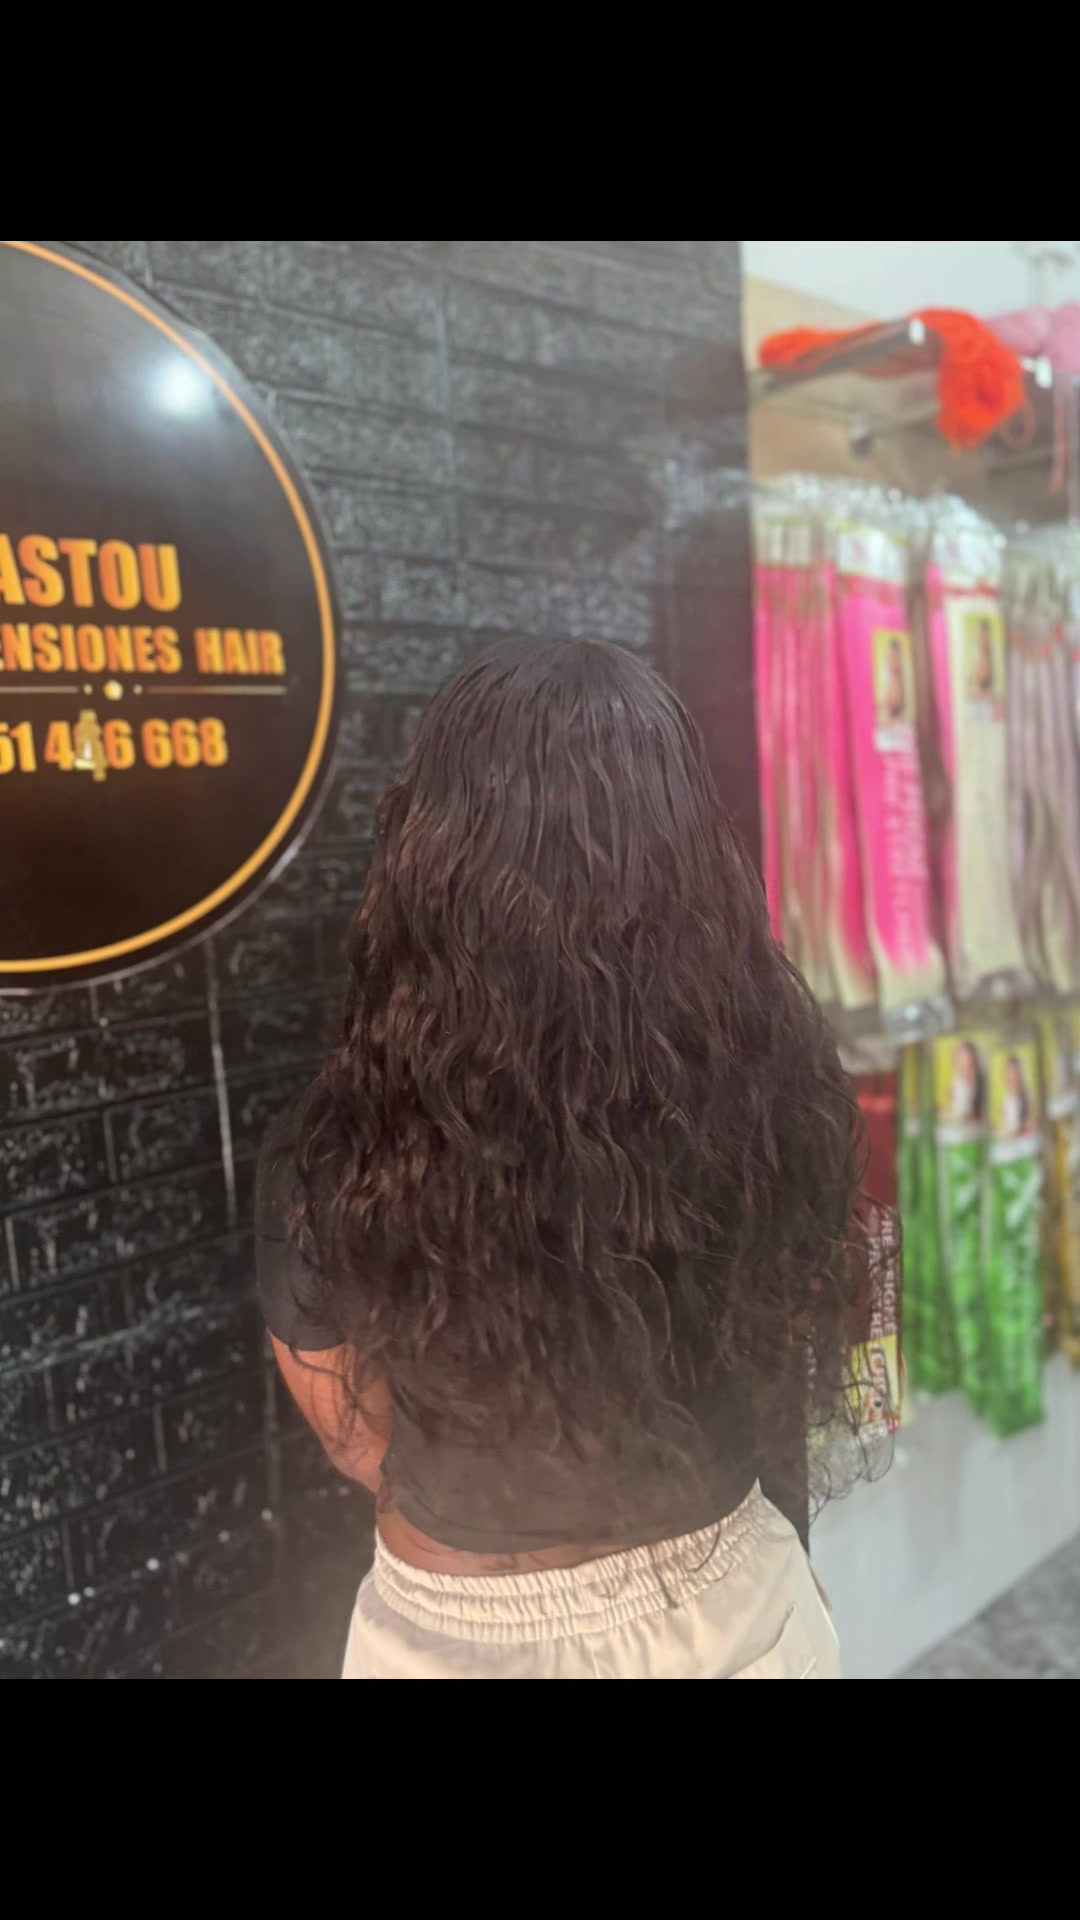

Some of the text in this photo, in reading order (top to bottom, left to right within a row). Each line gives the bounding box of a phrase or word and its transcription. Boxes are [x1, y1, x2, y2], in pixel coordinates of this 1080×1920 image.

[0, 623, 286, 675] NSIONES HAIR
[142, 718, 228, 767] 668
